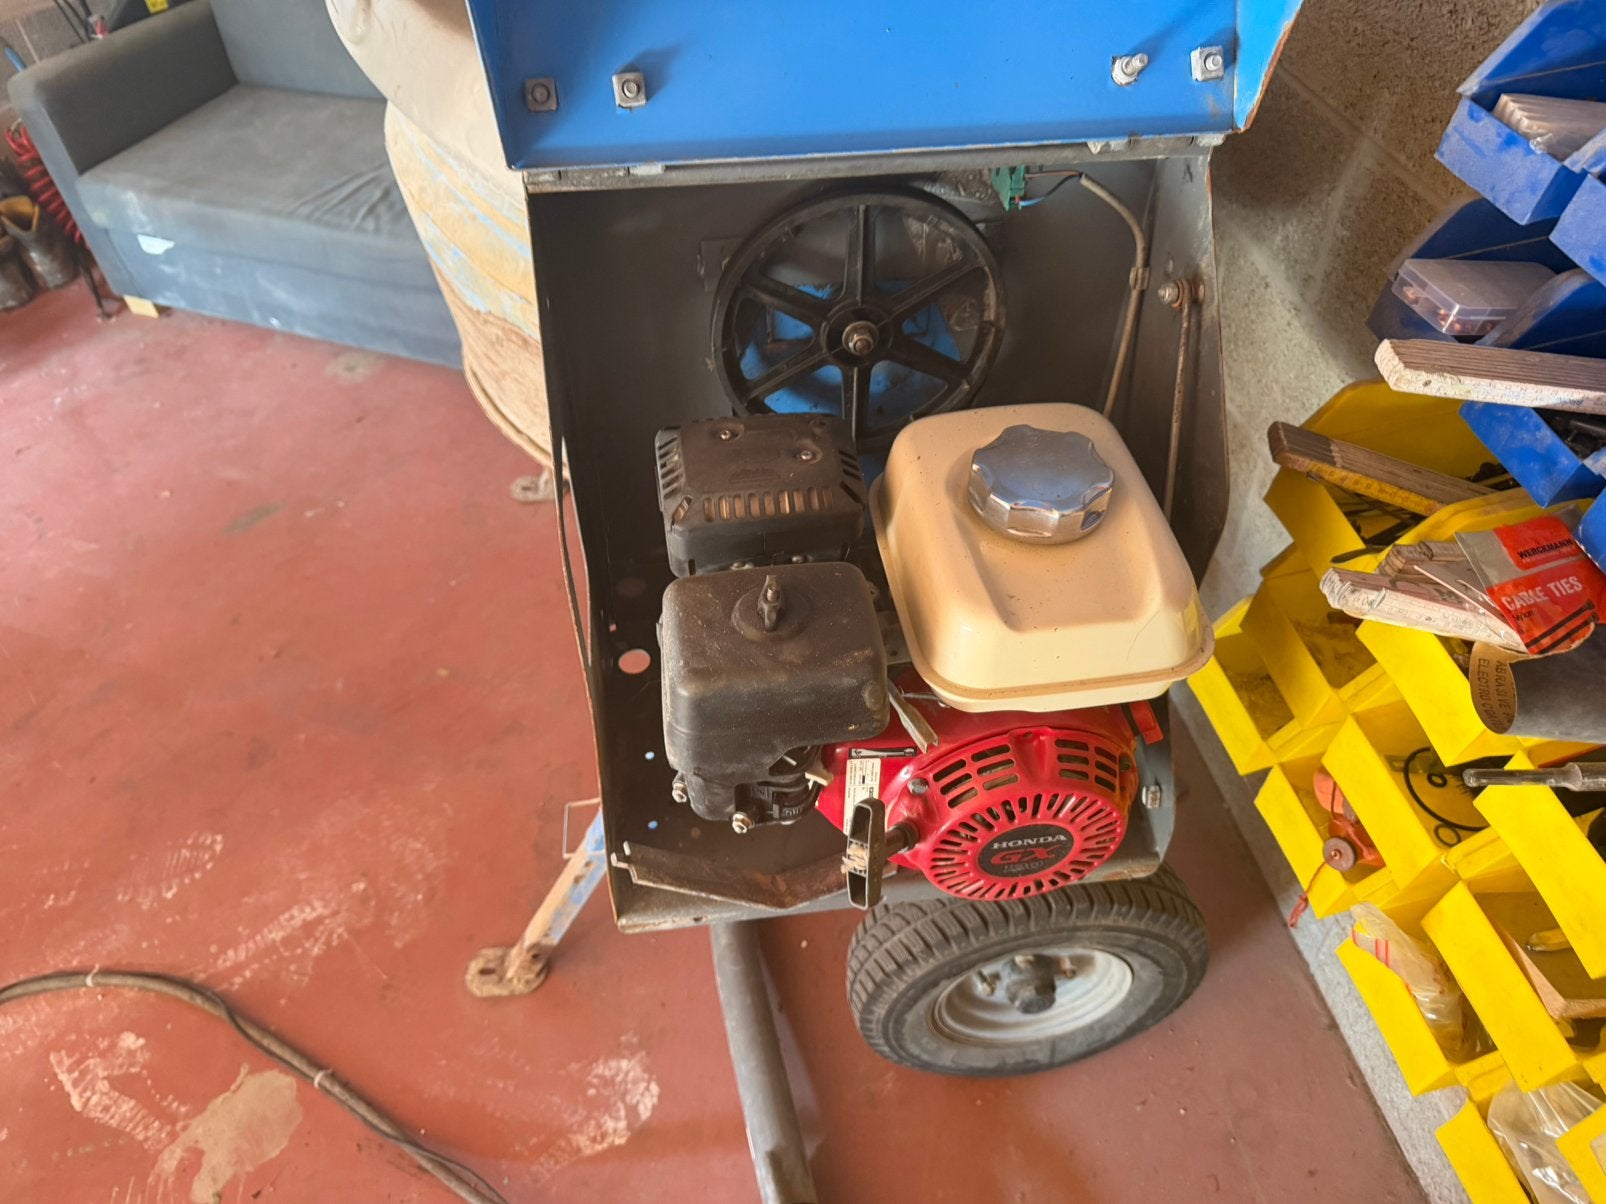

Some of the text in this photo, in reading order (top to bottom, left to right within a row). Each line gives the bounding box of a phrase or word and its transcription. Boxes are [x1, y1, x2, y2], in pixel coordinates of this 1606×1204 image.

[1517, 538, 1573, 559] WERCKMANN
[1501, 576, 1583, 611] CABLE TIES
[1477, 658, 1490, 701] ELECTRO
[1495, 660, 1512, 710] ABRASIVE
[991, 844, 1062, 865] GX
[992, 834, 1068, 849] HONDA
